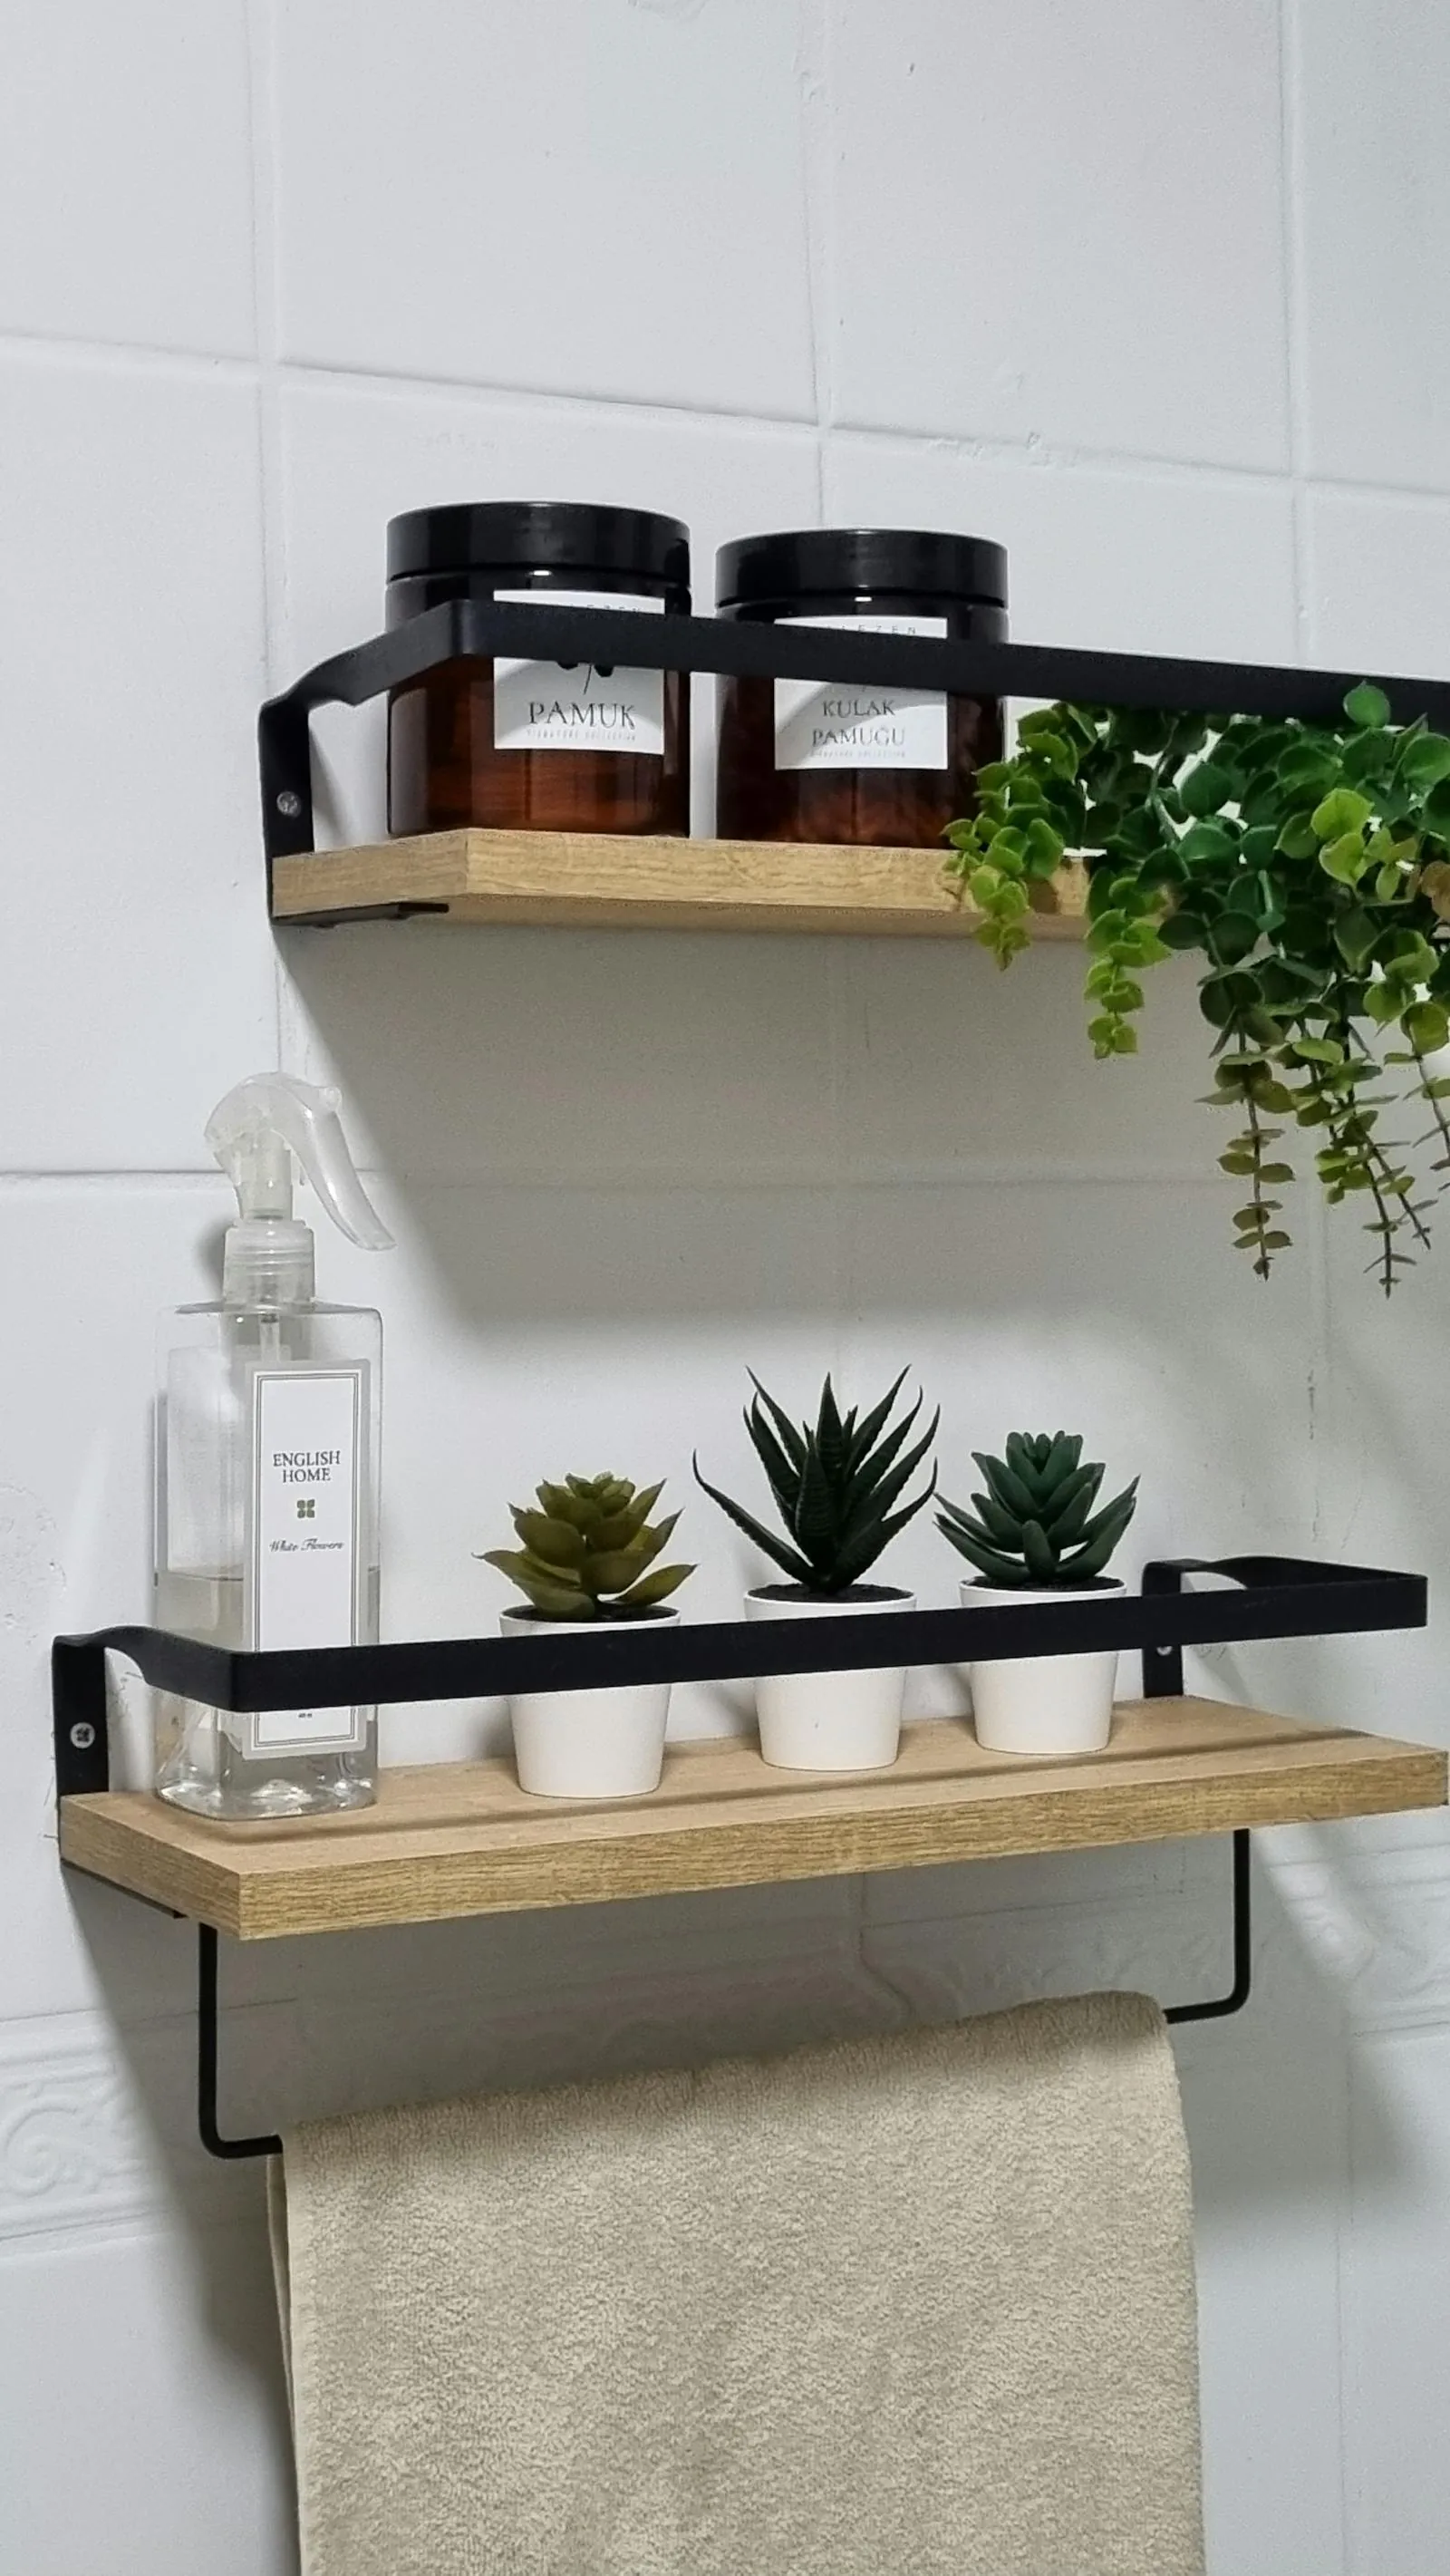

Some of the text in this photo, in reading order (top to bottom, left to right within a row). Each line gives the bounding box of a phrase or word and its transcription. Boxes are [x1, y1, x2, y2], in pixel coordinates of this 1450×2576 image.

[527, 700, 636, 731] PAMUK
[822, 699, 895, 717] KULAK
[273, 1450, 341, 1467] ENGLISH
[282, 1467, 332, 1483] HOME
